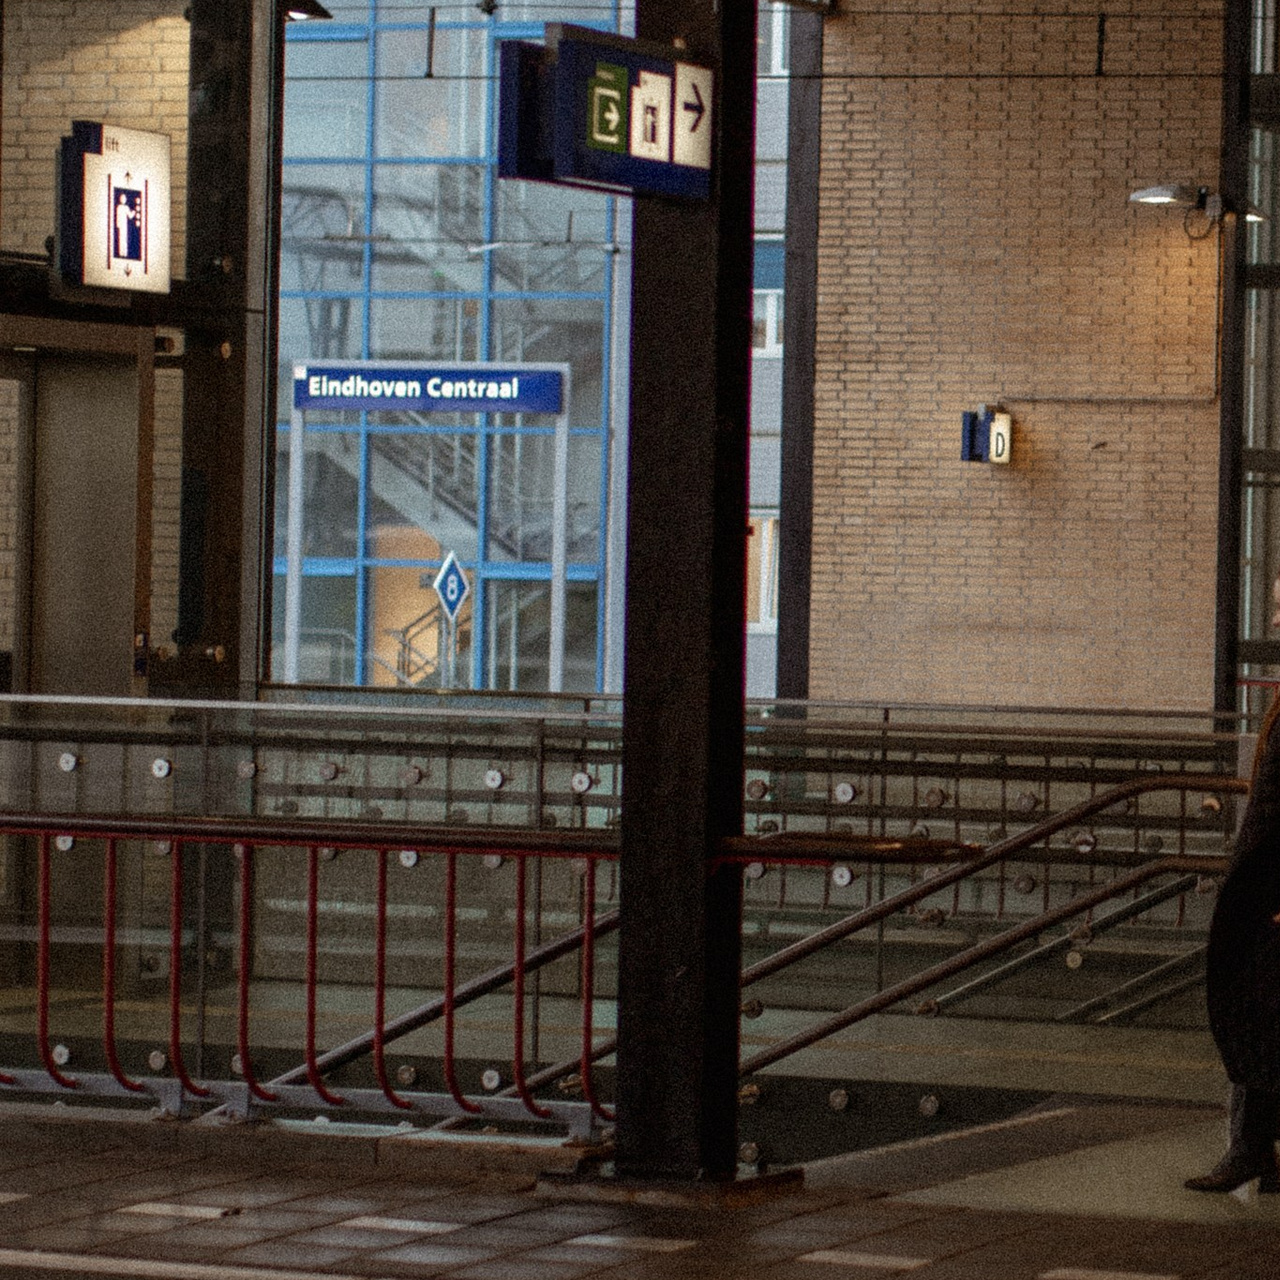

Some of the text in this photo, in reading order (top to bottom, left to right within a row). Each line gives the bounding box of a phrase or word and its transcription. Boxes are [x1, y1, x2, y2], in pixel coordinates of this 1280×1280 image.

[105, 136, 120, 153] lift
[308, 375, 519, 399] Eindhoven Centraal
[447, 574, 458, 601] 8
